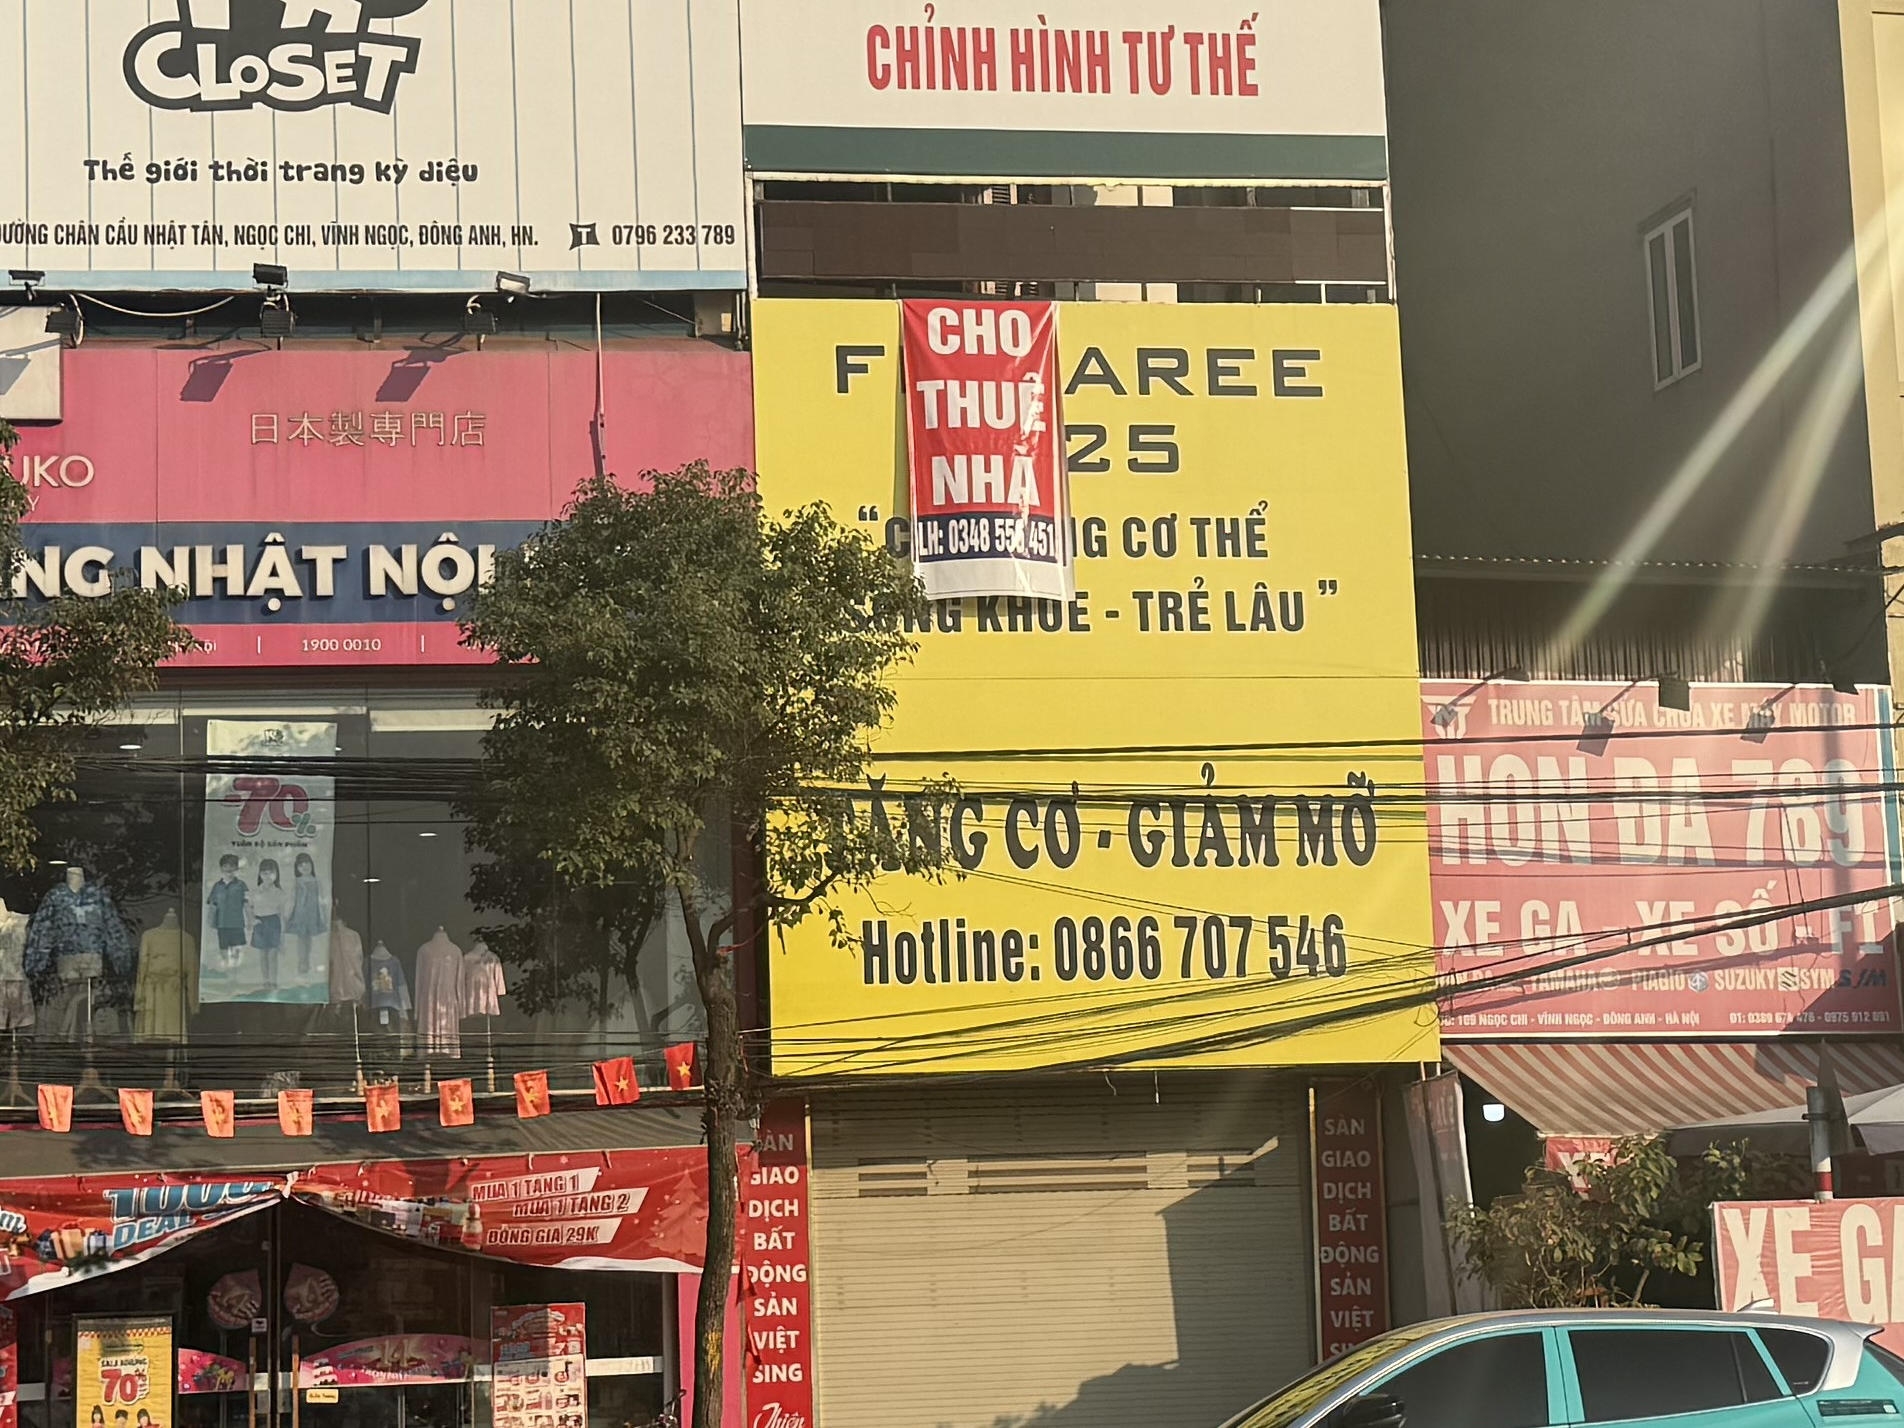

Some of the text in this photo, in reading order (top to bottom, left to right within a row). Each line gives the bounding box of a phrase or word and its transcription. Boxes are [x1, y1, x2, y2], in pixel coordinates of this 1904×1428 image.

[866, 2, 1259, 97] CHỈNH HÌNH TƯ THẾ
[83, 153, 479, 188] Thế giới thời trang kỳ diệu
[53, 221, 99, 246] CHÂN
[105, 217, 139, 246] CẦU
[144, 221, 186, 250] NHẬT
[192, 221, 228, 248] TÂN,
[234, 225, 278, 250] NGỌC
[284, 225, 316, 248] CHI,
[321, 221, 359, 246] VĨNH
[364, 225, 414, 250] NGỌC,
[418, 220, 462, 246] ĐÔNG
[468, 225, 506, 248] ANH,
[512, 225, 538, 246] HN.
[611, 224, 736, 245] 0796 233 789
[927, 307, 1032, 356] CHO
[916, 372, 1046, 432] THUÊ
[249, 410, 487, 448] 日本製専門店
[919, 521, 944, 556] LH:
[948, 517, 990, 555] 0348
[1123, 511, 1177, 559] CƠ
[1190, 498, 1268, 559] THỂ
[139, 531, 348, 612] NHẬT
[1132, 576, 1208, 633] TRẺ
[301, 639, 382, 652] 1900 0010
[1488, 699, 1554, 727] TRUNG
[1710, 702, 1736, 729] XE
[1005, 780, 1081, 870] CƠ
[1127, 762, 1279, 869] GIẢM
[1436, 754, 1592, 866] HON
[1439, 900, 1503, 957] XE
[1520, 900, 1588, 957] GA
[1635, 900, 1699, 957] XE
[863, 913, 1347, 985] Hotline: 0866 707 546
[1321, 1150, 1371, 1168] GIAO
[1323, 1181, 1372, 1204] DỊCH
[749, 1199, 799, 1222] DỊCH
[1328, 1208, 1369, 1232] BẤT
[753, 1225, 796, 1251] BẤT
[1320, 1241, 1380, 1268] ĐỘNG
[1722, 1206, 1820, 1316] XE
[1330, 1272, 1372, 1296] SẢN
[753, 1291, 798, 1317] SẢN
[1330, 1305, 1374, 1332] VIỆT
[753, 1325, 800, 1354] VIỆT
